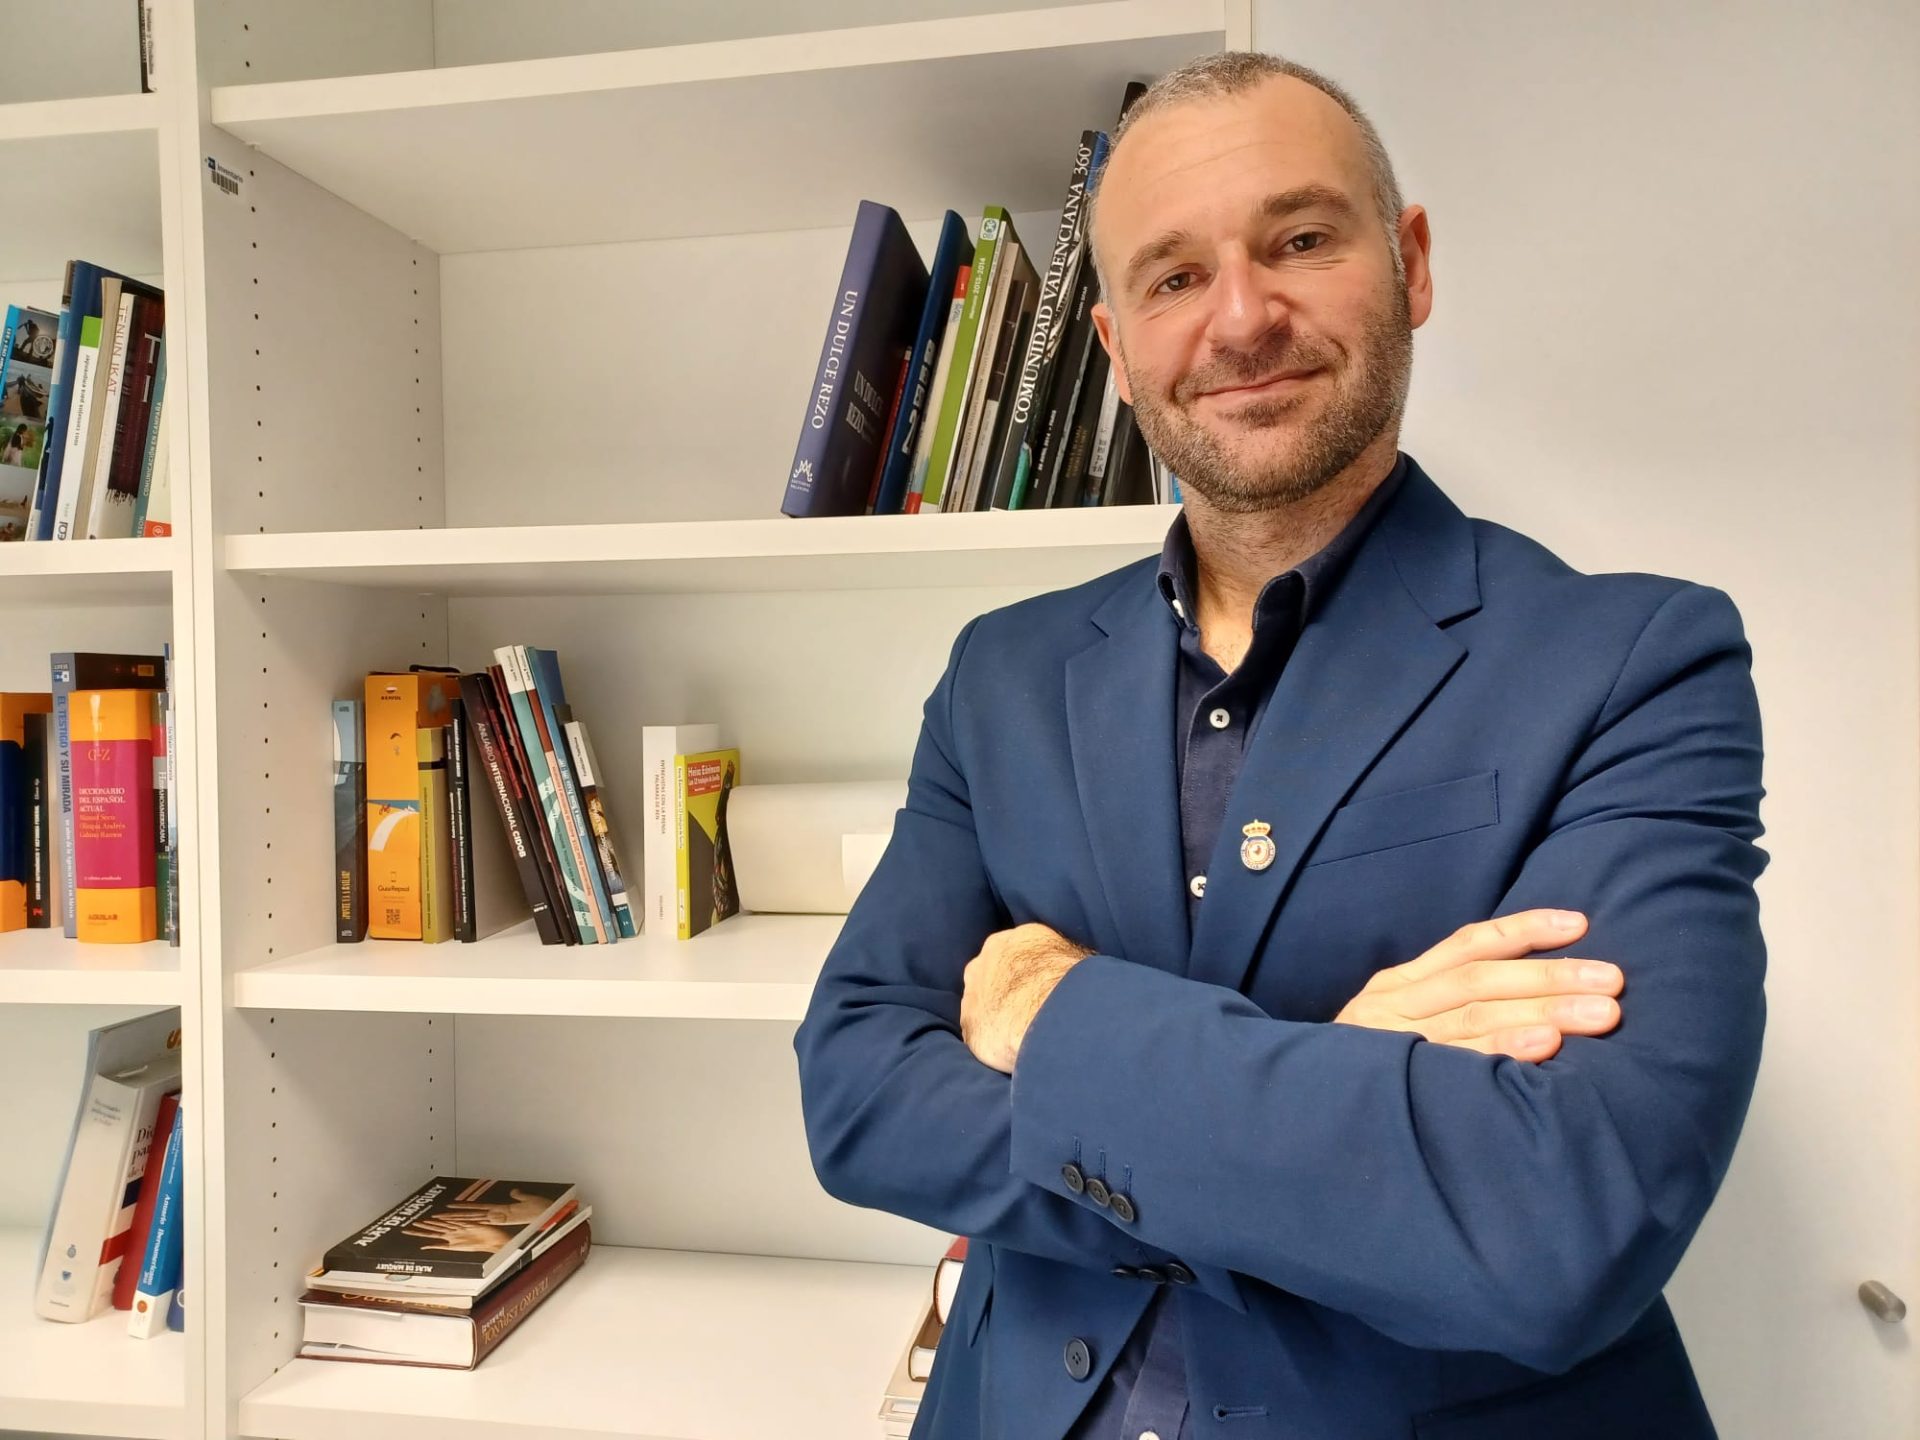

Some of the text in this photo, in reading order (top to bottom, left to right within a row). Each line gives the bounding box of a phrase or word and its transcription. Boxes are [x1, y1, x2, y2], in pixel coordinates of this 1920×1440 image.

[1014, 303, 1055, 425] COMUNIDAD
[1041, 180, 1085, 302] VALENCIANA
[107, 305, 129, 396] TENUN IKAT
[809, 288, 858, 430] UN DULCE REZO
[81, 354, 91, 389] emprender
[79, 389, 87, 403] para
[143, 401, 163, 496] COMUNICACIÓN EN CAMPAÑA
[56, 695, 66, 705] EL
[57, 709, 68, 748] TESTIGO
[59, 759, 69, 772] SU
[476, 722, 500, 761] ANUARIO
[490, 762, 517, 831] INTERNACIONAL
[60, 774, 71, 813] MIRADA
[79, 787, 125, 795] DICCIONARIO
[93, 795, 126, 804] ESPAÑOL
[160, 1194, 171, 1225] Anuario
[353, 1226, 391, 1247] ALAS
[384, 1215, 406, 1228] DE
